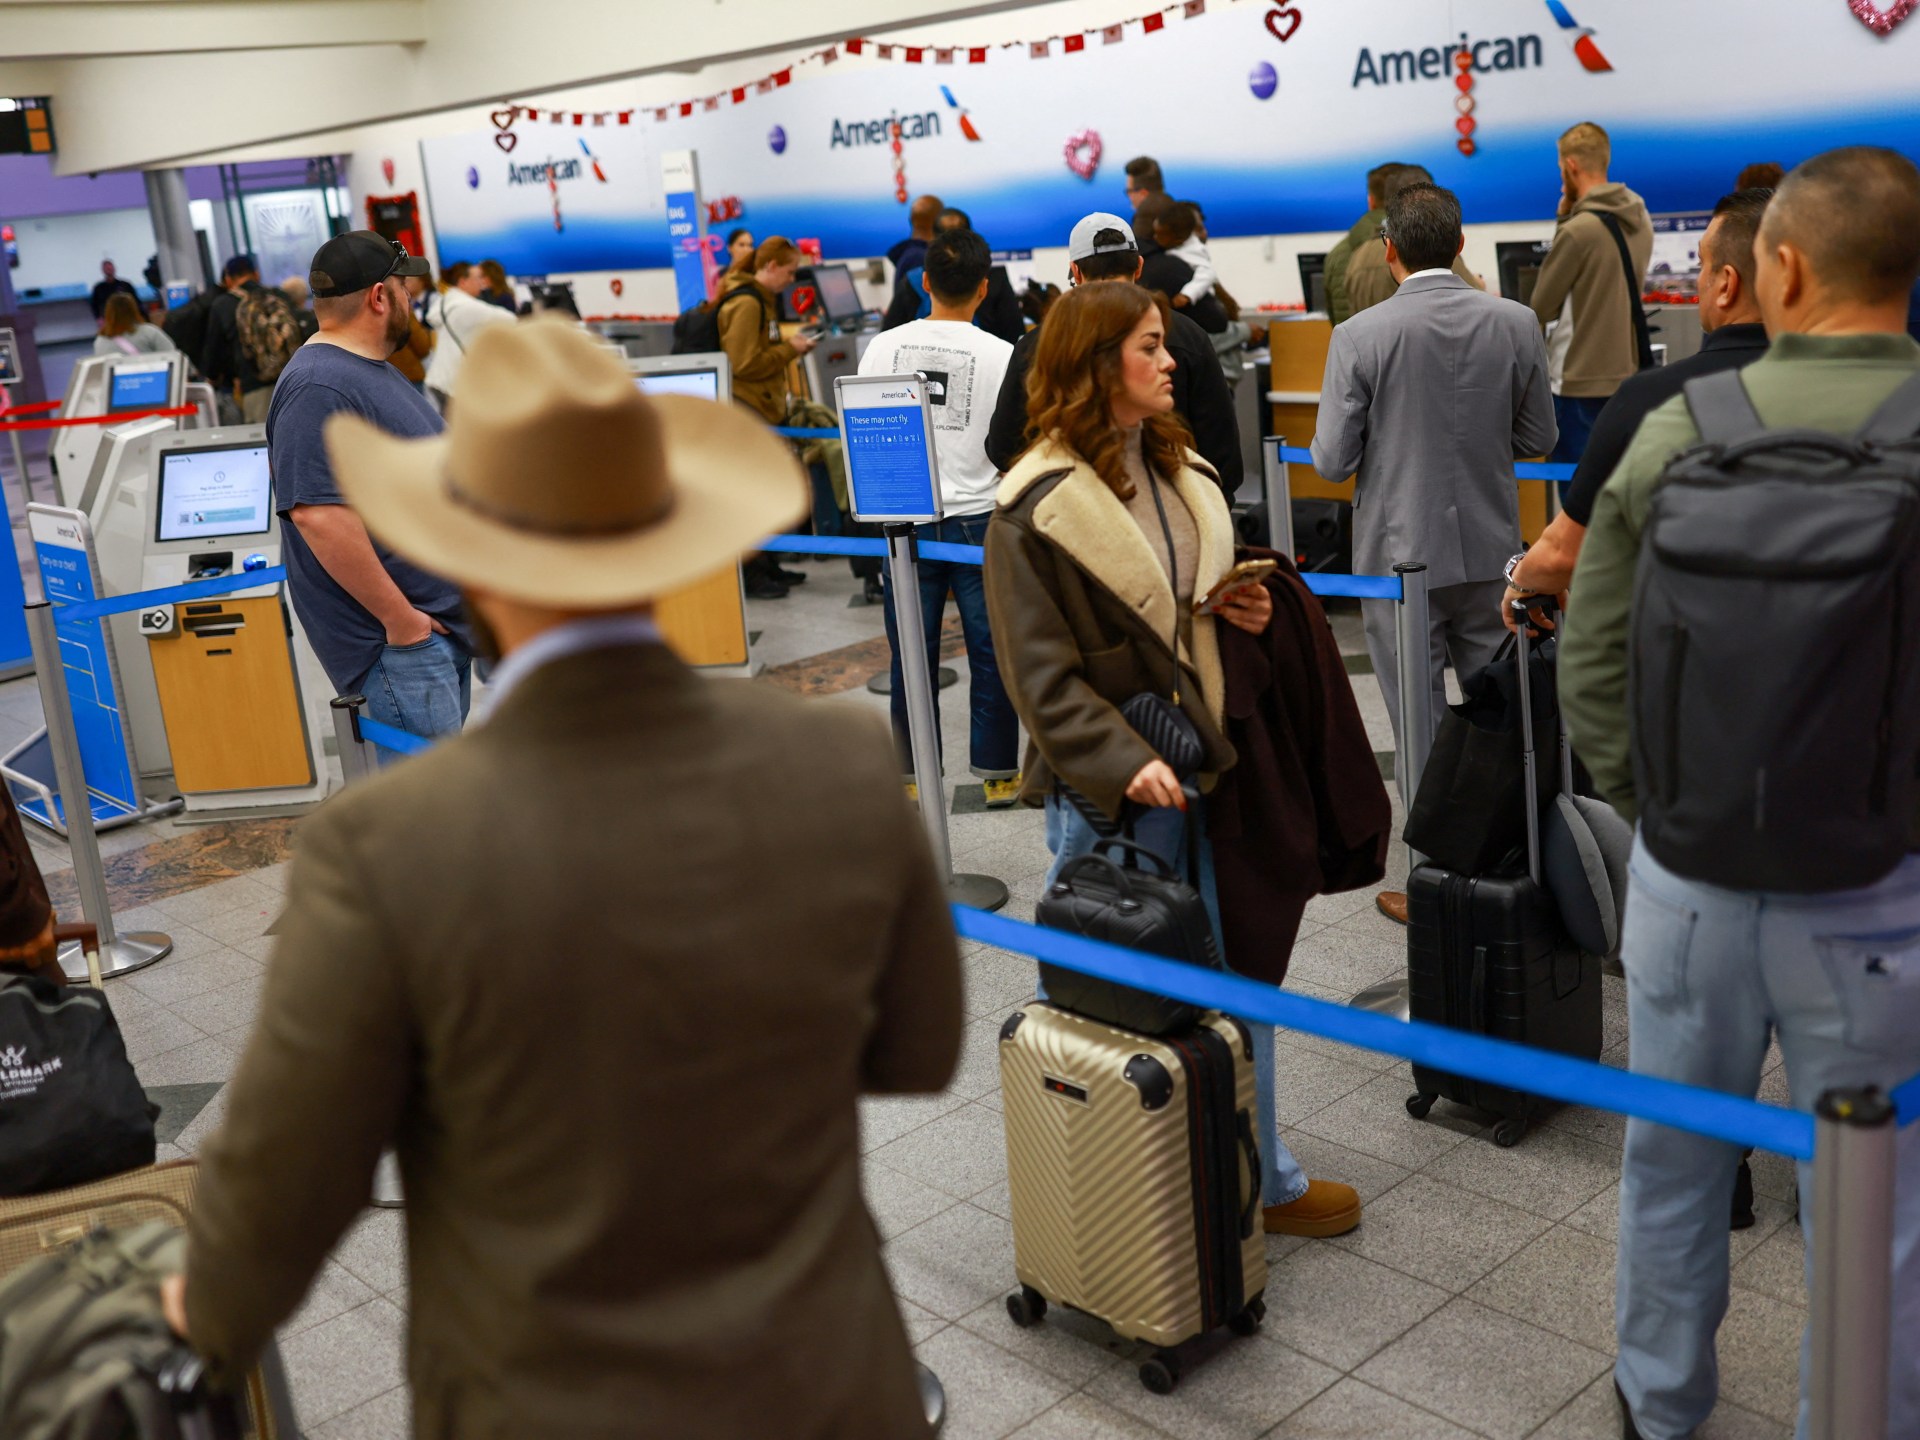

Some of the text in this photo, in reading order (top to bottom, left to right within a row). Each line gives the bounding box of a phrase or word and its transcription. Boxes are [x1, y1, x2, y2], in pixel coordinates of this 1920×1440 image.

[937, 347, 972, 356] EXPLORING
[881, 391, 908, 399] American
[965, 356, 976, 427] NEVER STOP EXPLORING
[850, 416, 870, 425] These
[870, 416, 885, 426] may
[886, 415, 898, 424] not
